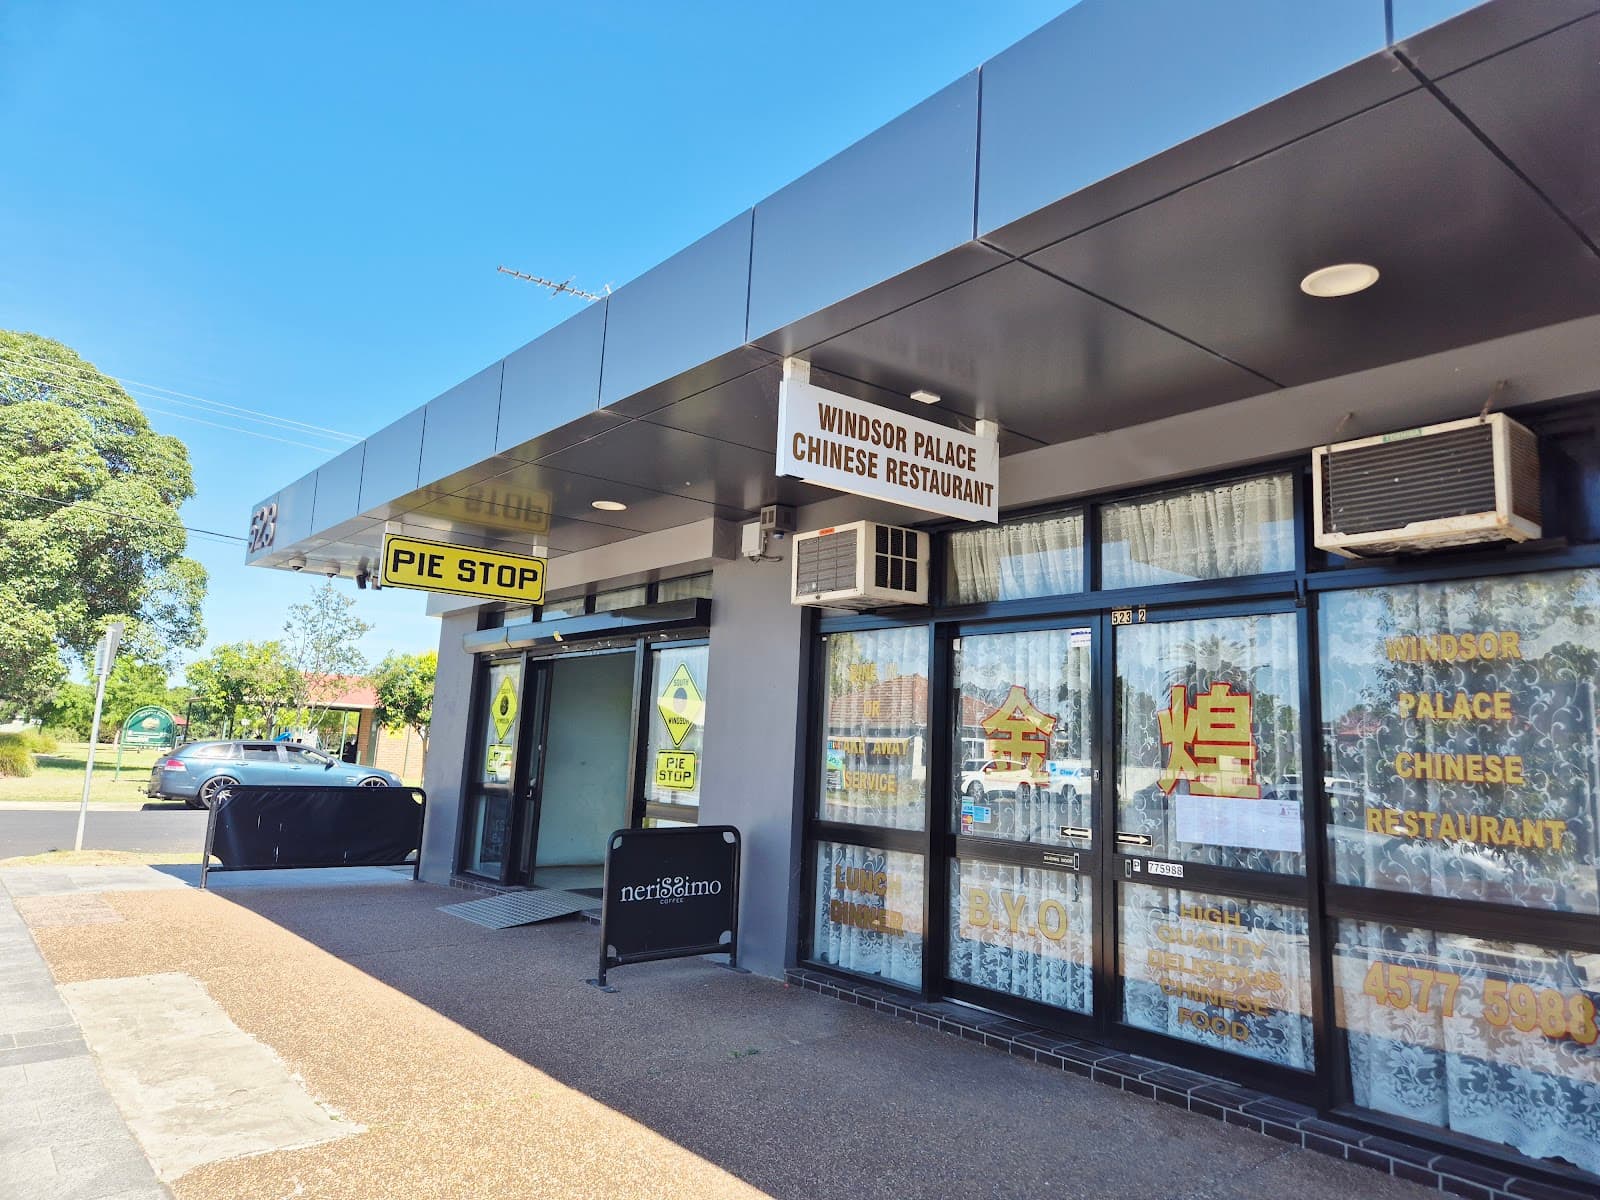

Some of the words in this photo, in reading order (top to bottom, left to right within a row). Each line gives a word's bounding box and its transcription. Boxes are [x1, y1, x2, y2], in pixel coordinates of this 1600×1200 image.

[818, 402, 907, 453] WINDSOR
[914, 431, 977, 472] PALACE
[792, 432, 878, 479] CHINESE
[886, 457, 994, 507] RESTAURANT
[392, 549, 445, 579] PIE
[457, 559, 538, 589] STOP
[1112, 611, 1131, 624] 523
[1139, 610, 1145, 622] 2
[1385, 630, 1522, 663] WINDSOR
[864, 700, 881, 717] OR
[1397, 692, 1513, 720] PALACE
[873, 739, 911, 756] AWAY
[981, 685, 1056, 788] 金
[1157, 681, 1262, 799] 煌
[659, 770, 691, 782] STOP
[666, 757, 686, 770] PIE
[1395, 752, 1525, 785] CHINESE
[844, 771, 897, 793] SERVICE
[1366, 807, 1567, 850] RESTAURANT
[835, 864, 901, 897] LUNCH
[1149, 862, 1183, 877] 775988
[830, 899, 904, 937] DINNER
[1180, 903, 1241, 929] HIGH
[1158, 925, 1266, 960] QUALITY
[1147, 949, 1284, 991] DELICIOUS
[1160, 977, 1270, 1017] CHINESE
[1363, 960, 1461, 1018] 4577
[1483, 978, 1599, 1046] 5988
[1178, 1006, 1249, 1041] FOOD
